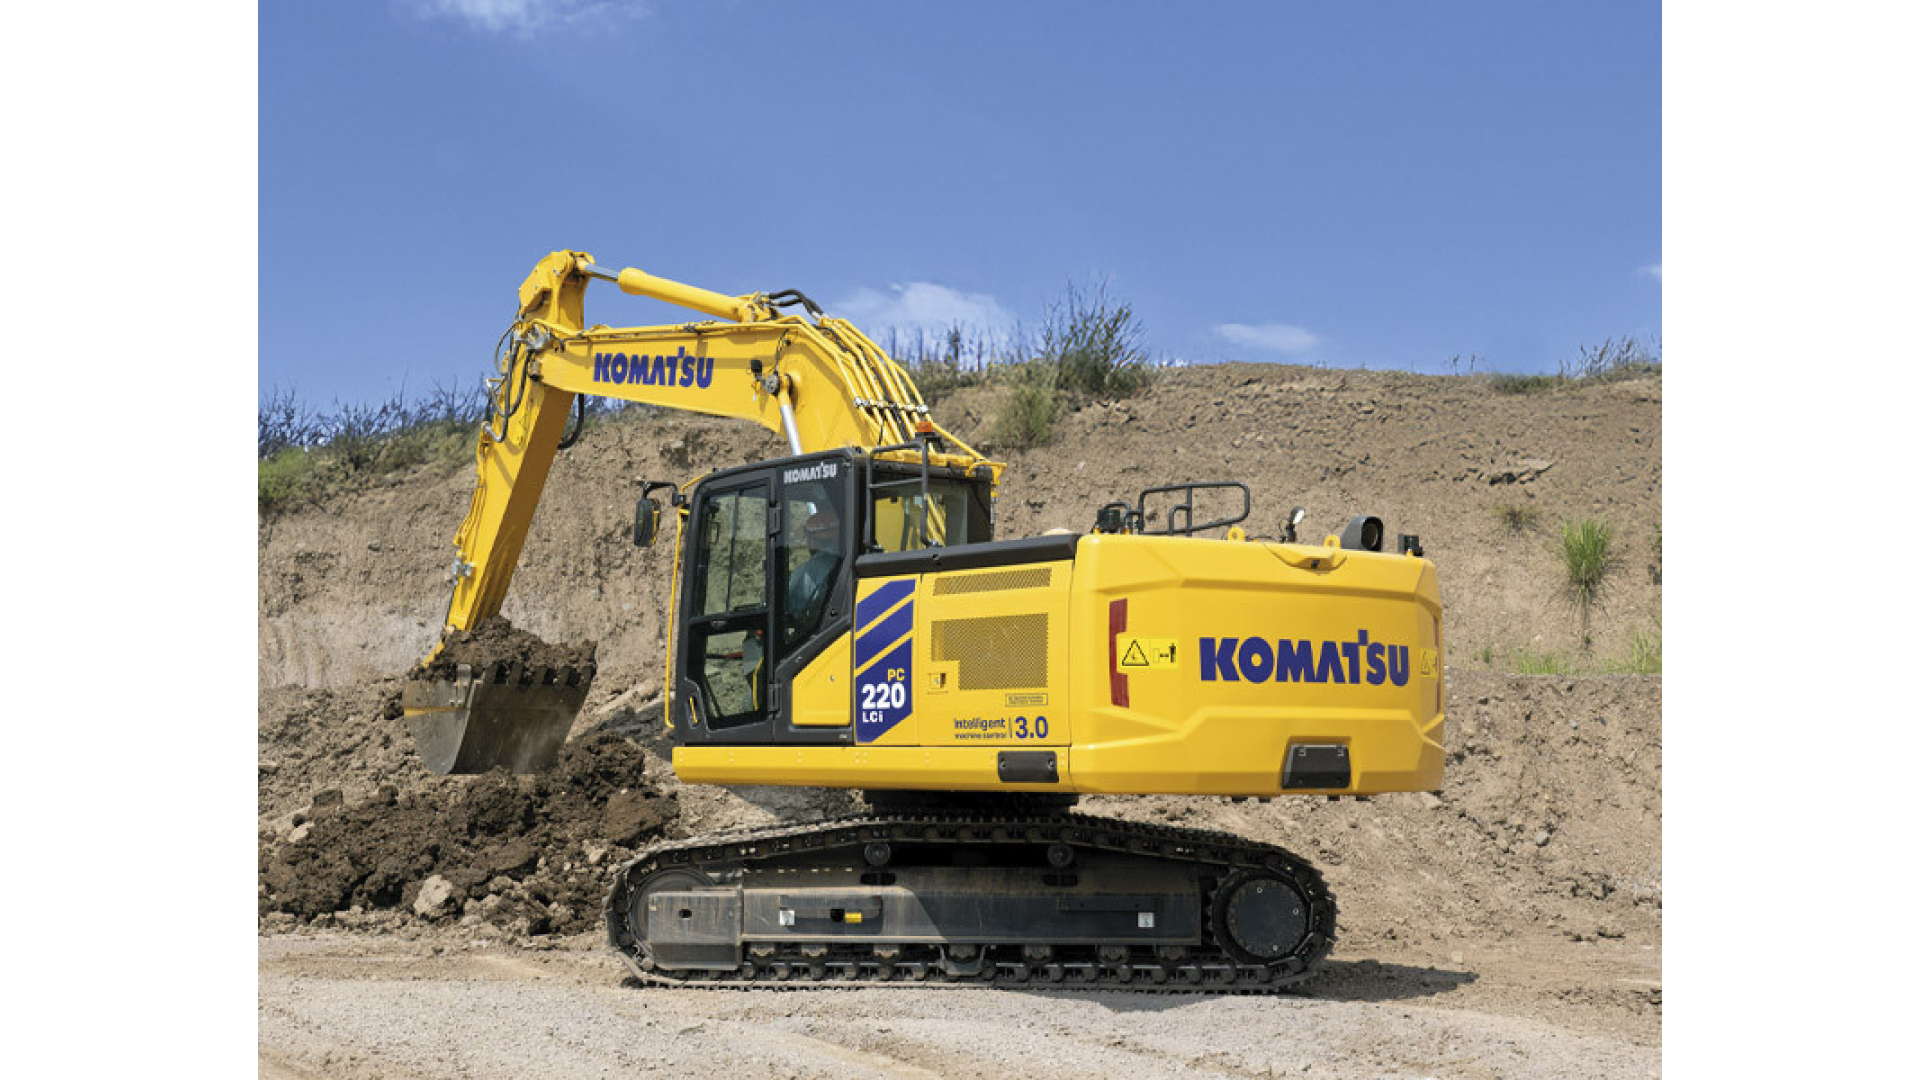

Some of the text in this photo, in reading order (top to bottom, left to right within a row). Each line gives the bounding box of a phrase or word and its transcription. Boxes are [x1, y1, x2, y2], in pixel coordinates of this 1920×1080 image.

[593, 346, 715, 389] KOMATSU
[783, 461, 837, 484] KOMATSU
[1199, 628, 1410, 687] KOMATSU
[887, 667, 905, 682] PC
[861, 682, 906, 709] 220
[1015, 715, 1049, 739] 3.0
